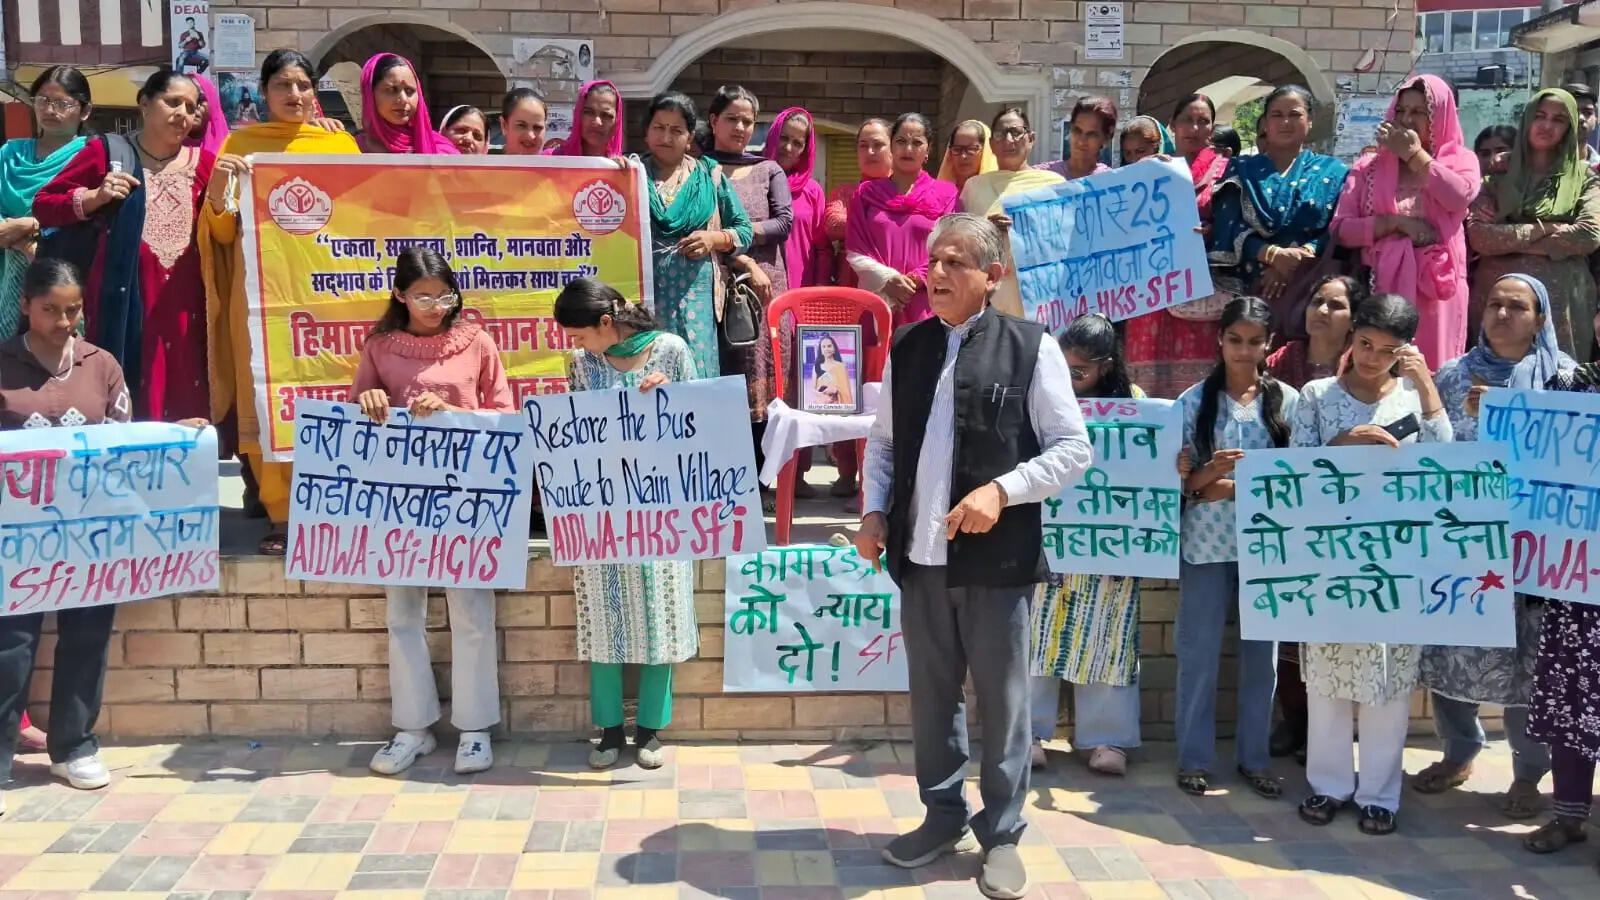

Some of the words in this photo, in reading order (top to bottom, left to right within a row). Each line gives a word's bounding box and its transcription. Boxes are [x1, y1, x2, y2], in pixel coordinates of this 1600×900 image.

[174, 5, 208, 15] DEAL
[506, 238, 561, 257] मानवता
[564, 233, 592, 257] और
[1148, 225, 1175, 279] दो
[367, 267, 384, 291] के
[473, 266, 526, 290] मिलकर
[530, 271, 558, 289] साथ
[290, 311, 374, 357] हिमाच
[524, 395, 608, 452] Restore
[617, 390, 646, 441] the
[656, 388, 697, 441] Bus
[1077, 399, 1138, 418] GVS
[1485, 392, 1580, 467] परिवार
[0, 449, 67, 505] या
[483, 429, 523, 475] पर
[538, 459, 594, 508] Route
[597, 458, 614, 506] to
[621, 457, 671, 505] Nain
[1074, 467, 1143, 520] तीन
[1312, 458, 1365, 505] के
[456, 478, 521, 538] करो
[1241, 512, 1294, 566] को
[1511, 530, 1600, 594] DWA-
[730, 584, 787, 636] को
[813, 593, 893, 630] न्याय
[1325, 563, 1414, 613] करो
[857, 631, 903, 676] SF
